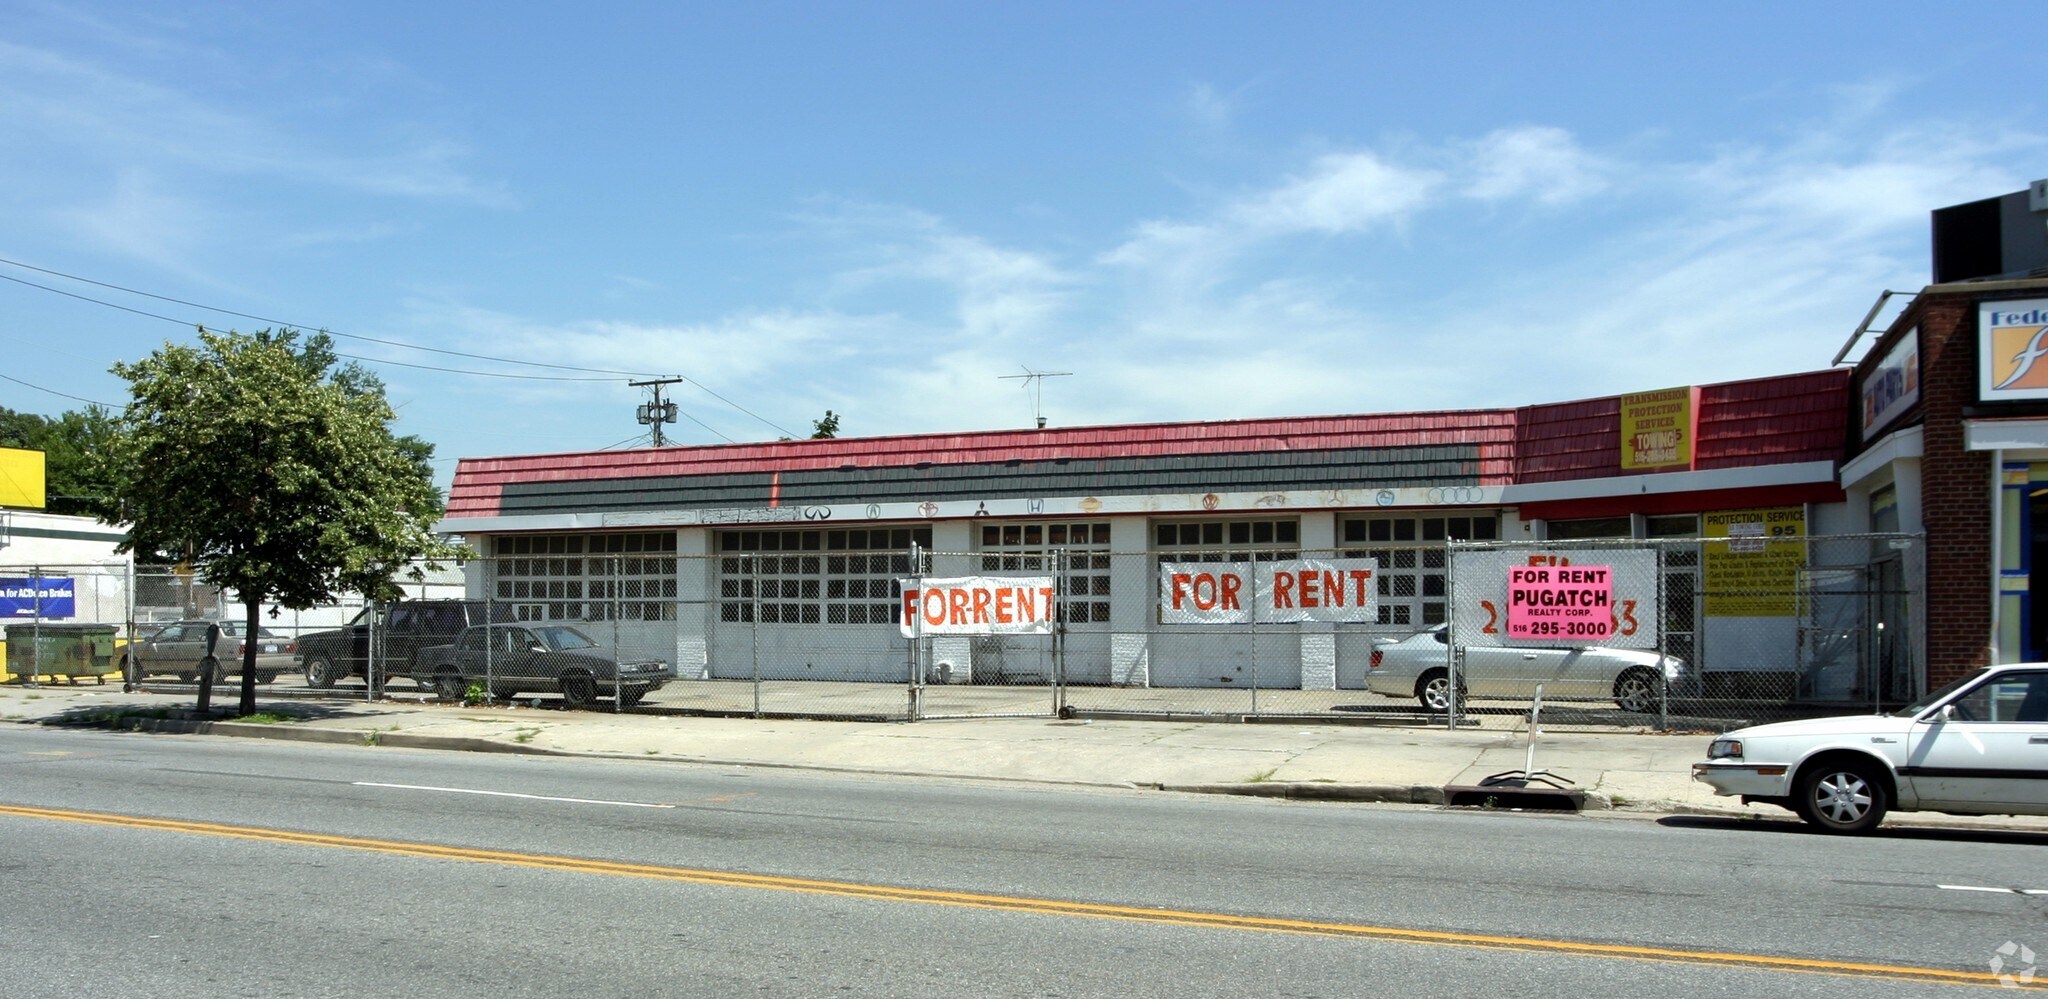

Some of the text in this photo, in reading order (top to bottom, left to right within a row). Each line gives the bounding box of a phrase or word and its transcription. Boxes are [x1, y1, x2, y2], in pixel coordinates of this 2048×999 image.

[1624, 389, 1688, 406] TRANSMISSION
[1629, 404, 1683, 418] PROTECTION
[1635, 417, 1675, 430] SERVICES
[1637, 431, 1674, 449] TOWING
[1708, 513, 1763, 525] PROTECTION
[1771, 525, 1796, 535] 95
[1513, 571, 1607, 583] FOR RENT
[6, 588, 18, 597] for
[49, 588, 73, 598] Brakes
[1172, 569, 1372, 610] FOR RENT
[1513, 589, 1607, 606] PUGATCH
[1527, 608, 1593, 617] REALTY CORP.
[1531, 622, 1607, 635] 295-3000
